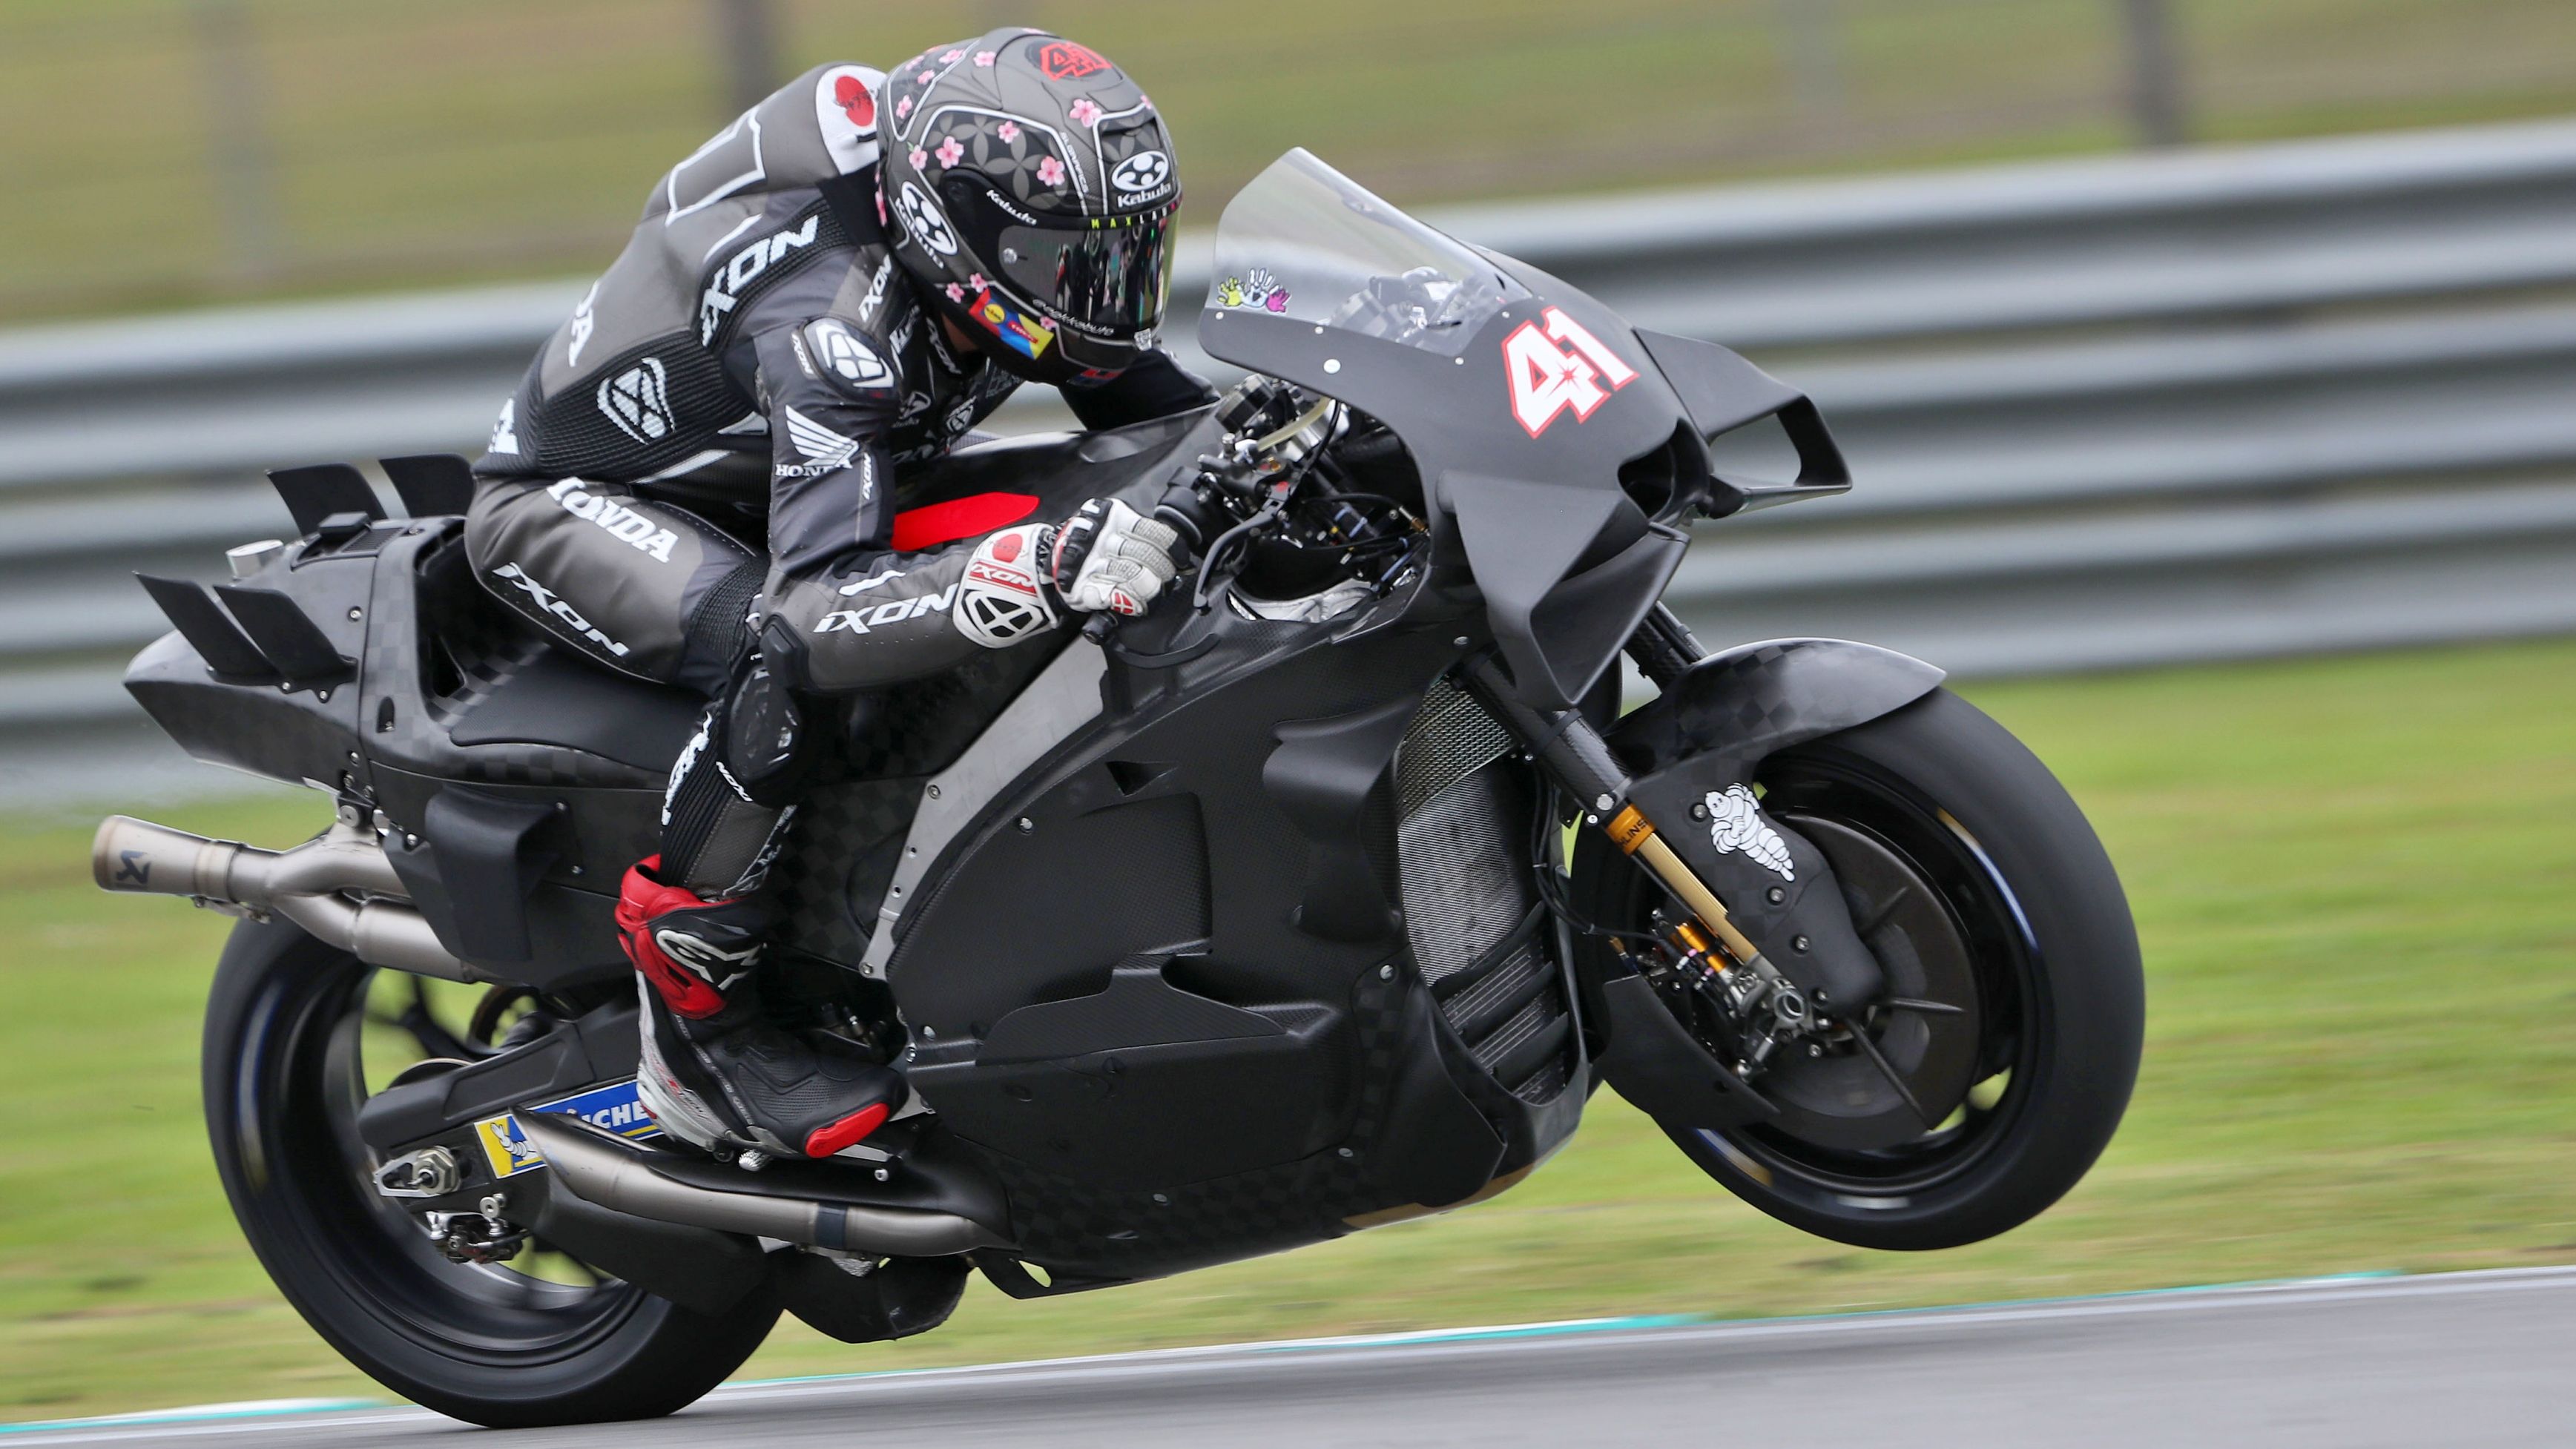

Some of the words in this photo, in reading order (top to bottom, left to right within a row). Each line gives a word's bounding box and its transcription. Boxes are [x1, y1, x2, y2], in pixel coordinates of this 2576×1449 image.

[986, 189, 1037, 225] Kabuto
[1117, 183, 1171, 208] Kabuto
[895, 197, 944, 269] Kabuto
[701, 215, 819, 348] IXON
[858, 254, 892, 323] IXON
[791, 333, 814, 374] IXON
[1501, 305, 1641, 439] 41
[862, 452, 874, 501] IXON
[972, 564, 1036, 588] IXON
[493, 561, 630, 657] IXON
[813, 583, 959, 634] IXON
[716, 761, 754, 802] IXON
